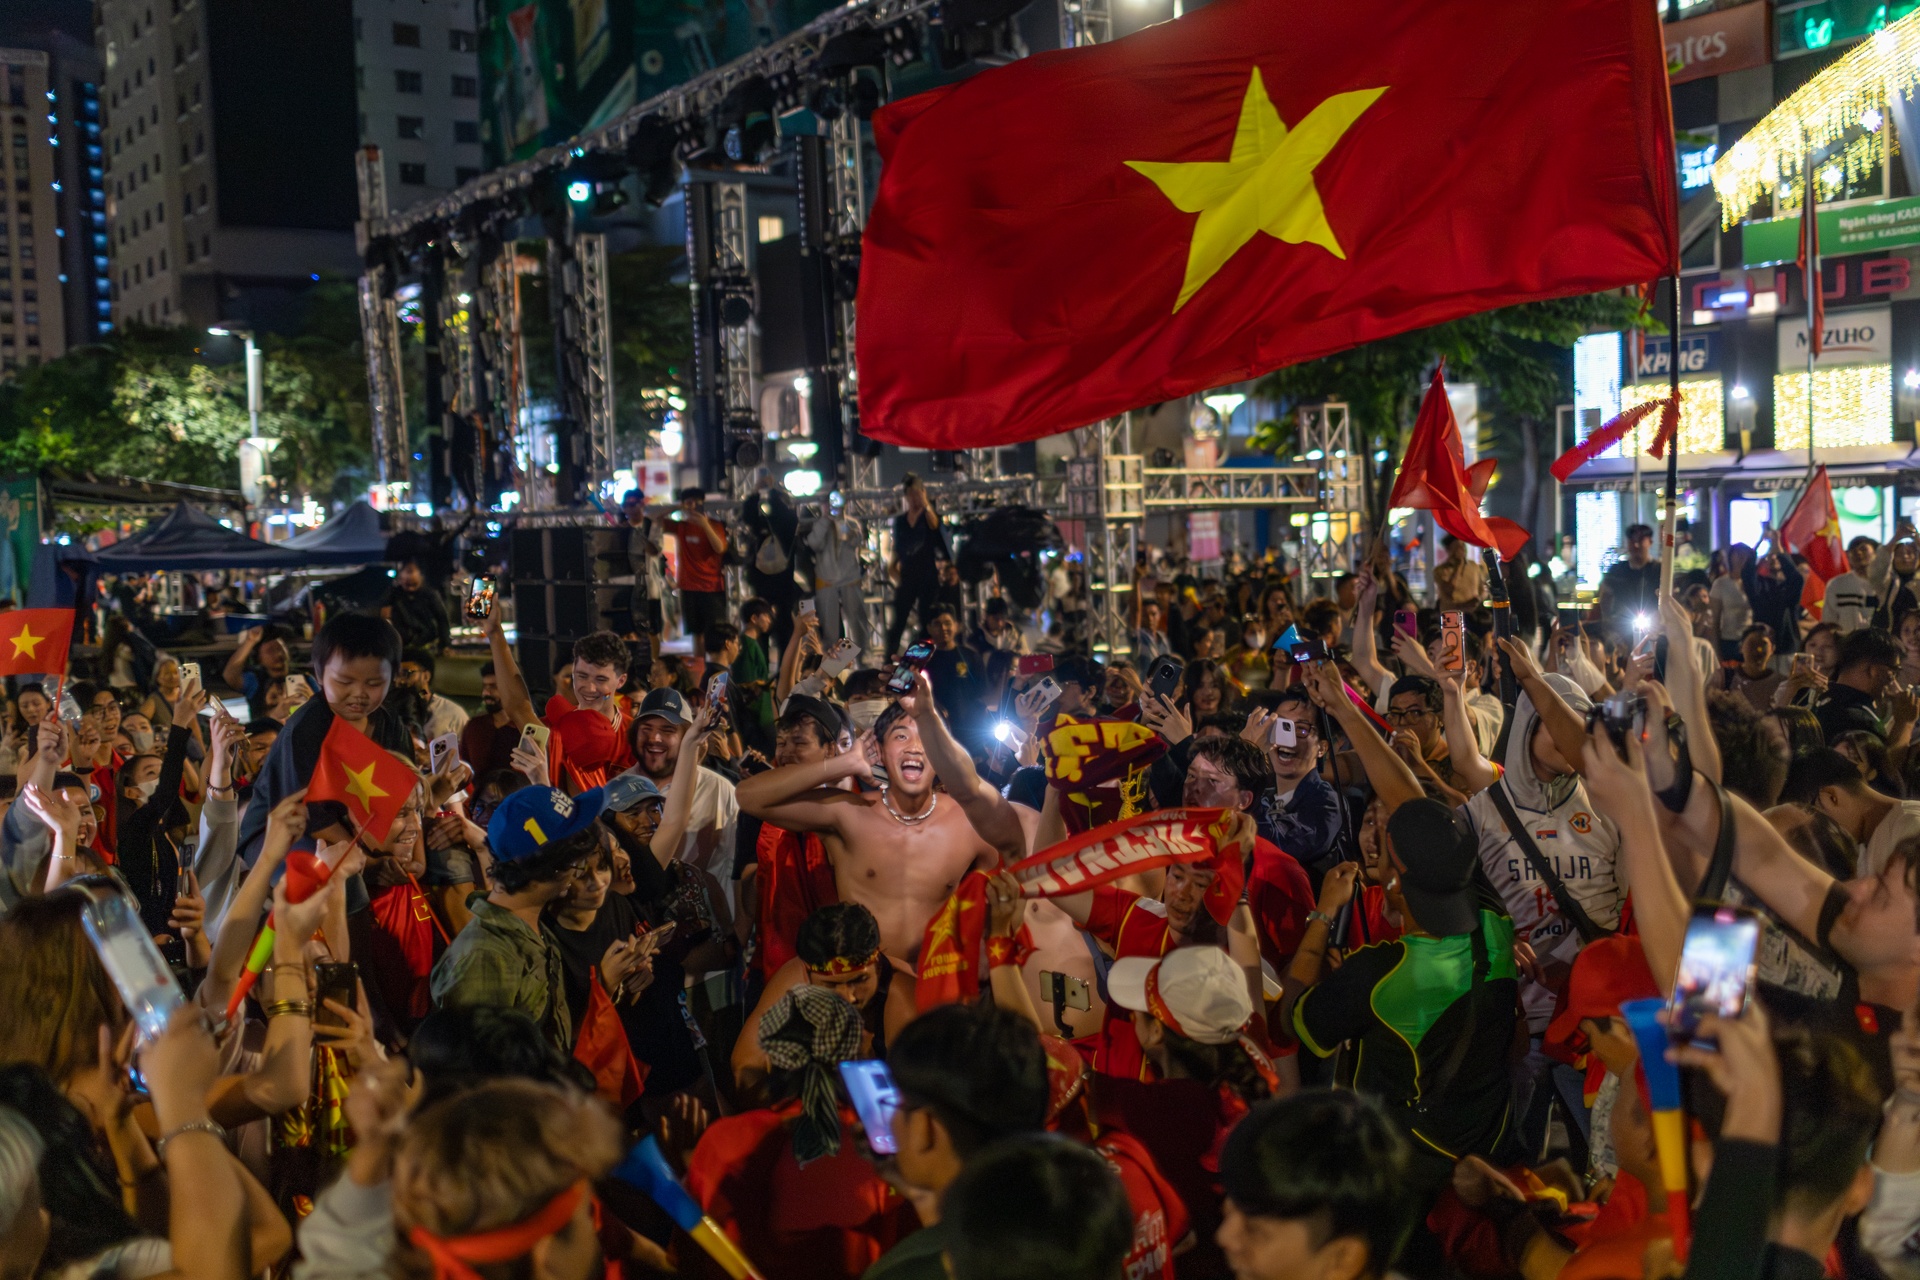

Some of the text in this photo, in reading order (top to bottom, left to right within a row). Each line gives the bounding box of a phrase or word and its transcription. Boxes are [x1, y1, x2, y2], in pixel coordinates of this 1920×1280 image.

[1666, 31, 1727, 64] ates
[1796, 326, 1875, 348] MZUHO
[523, 817, 549, 846] 1
